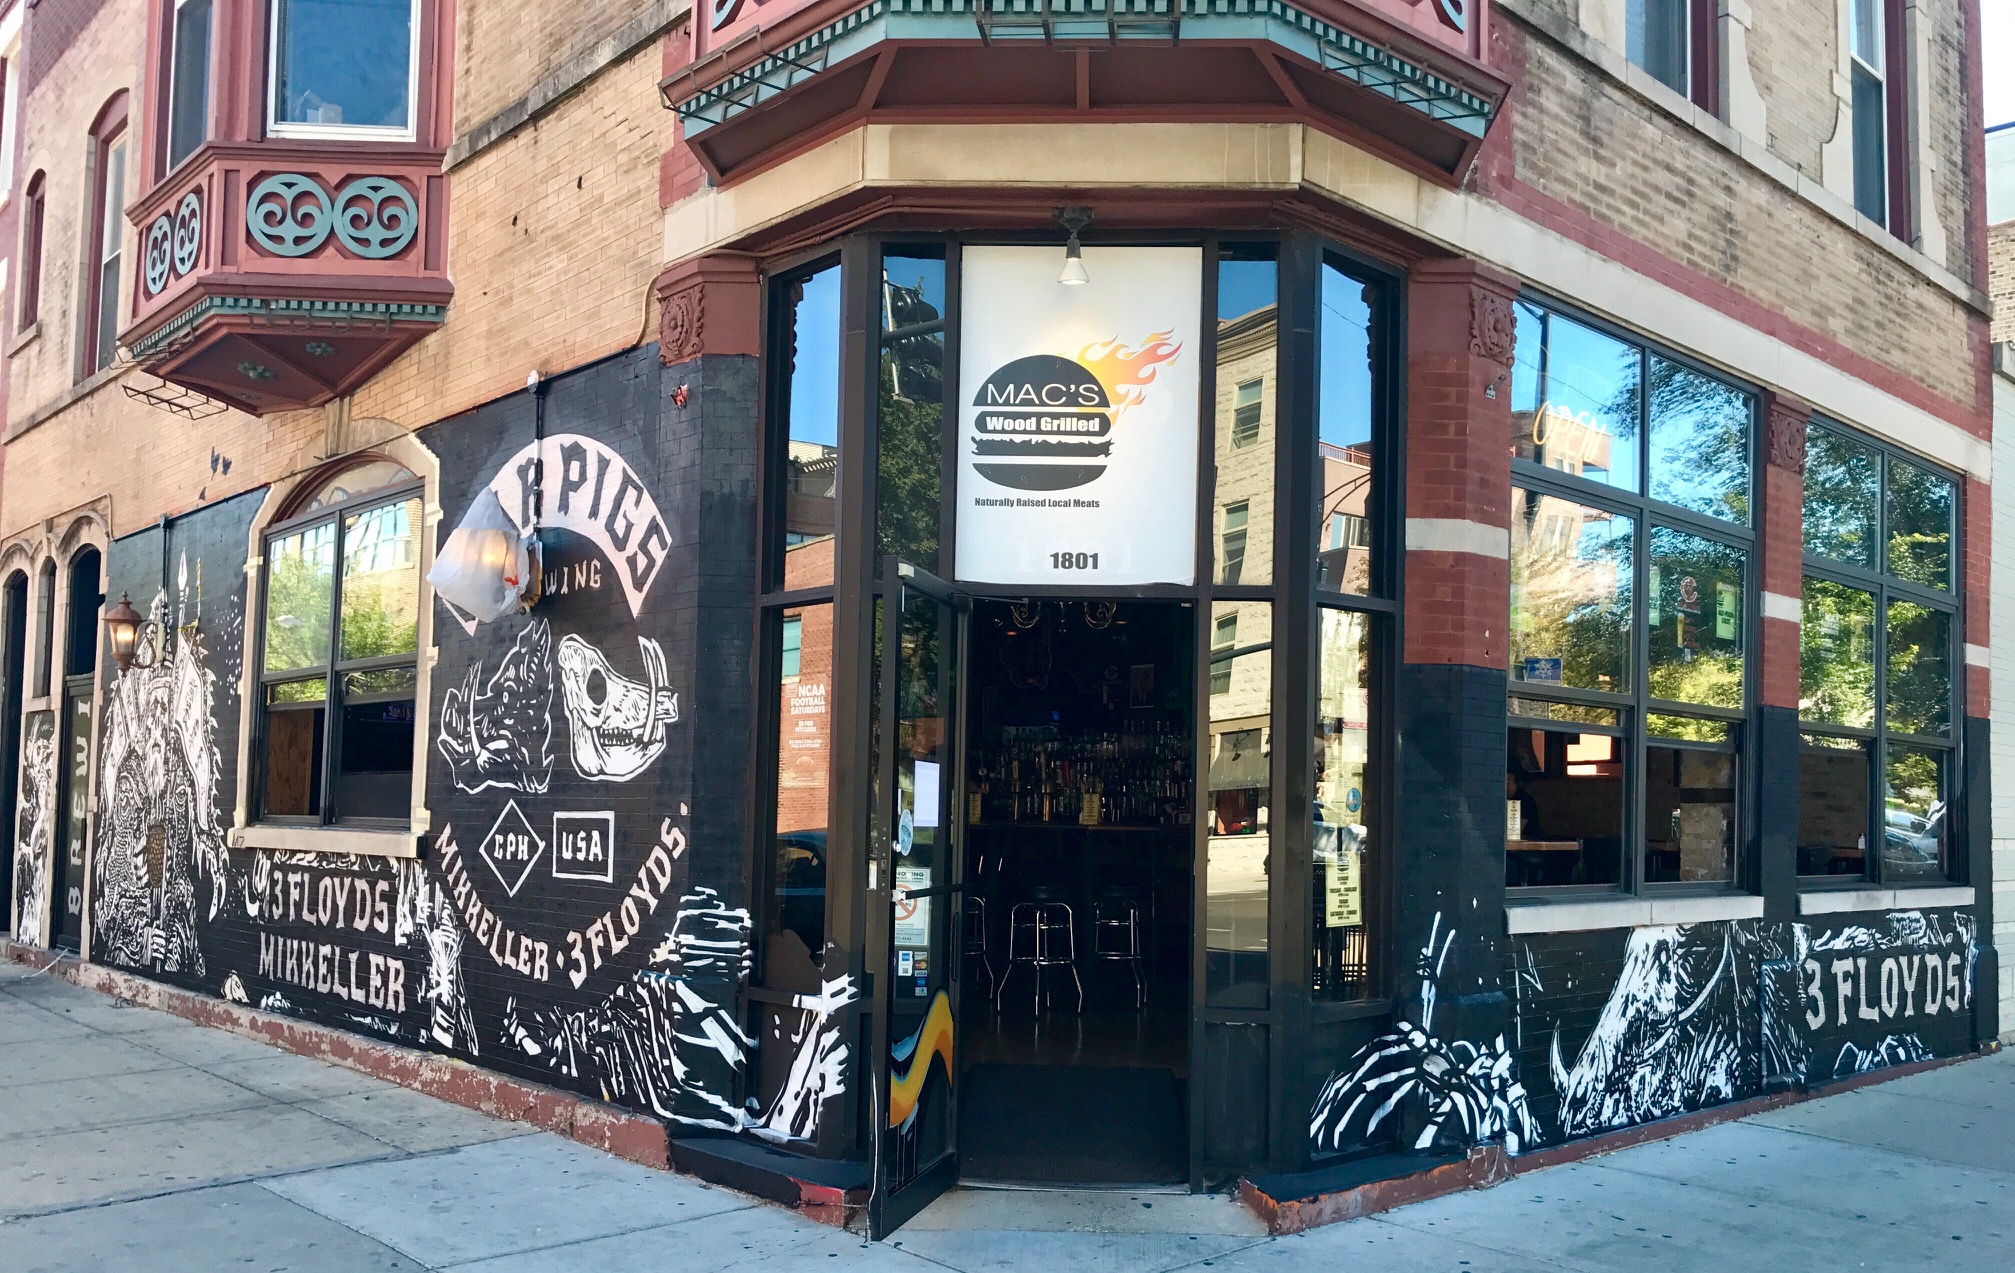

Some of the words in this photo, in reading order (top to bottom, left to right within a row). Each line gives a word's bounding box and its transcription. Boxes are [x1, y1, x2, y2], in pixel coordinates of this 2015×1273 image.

[986, 383, 1100, 406] MAC'S
[985, 416, 1037, 431] Wood
[1040, 417, 1101, 432] Grilled
[974, 498, 1015, 508] Naturally
[1016, 499, 1047, 508] Raised
[1048, 499, 1072, 508] Local
[1073, 500, 1100, 508] Meats
[1049, 552, 1099, 570] 1801
[544, 558, 602, 596] WING
[798, 684, 826, 697] NCAA
[790, 696, 826, 707] FOOTBALL
[790, 705, 826, 715] SATURDAYS
[493, 832, 529, 861] CPH
[562, 830, 603, 862] USA
[434, 822, 549, 982] MIKKELLER
[258, 930, 406, 1014] MIKKELLER
